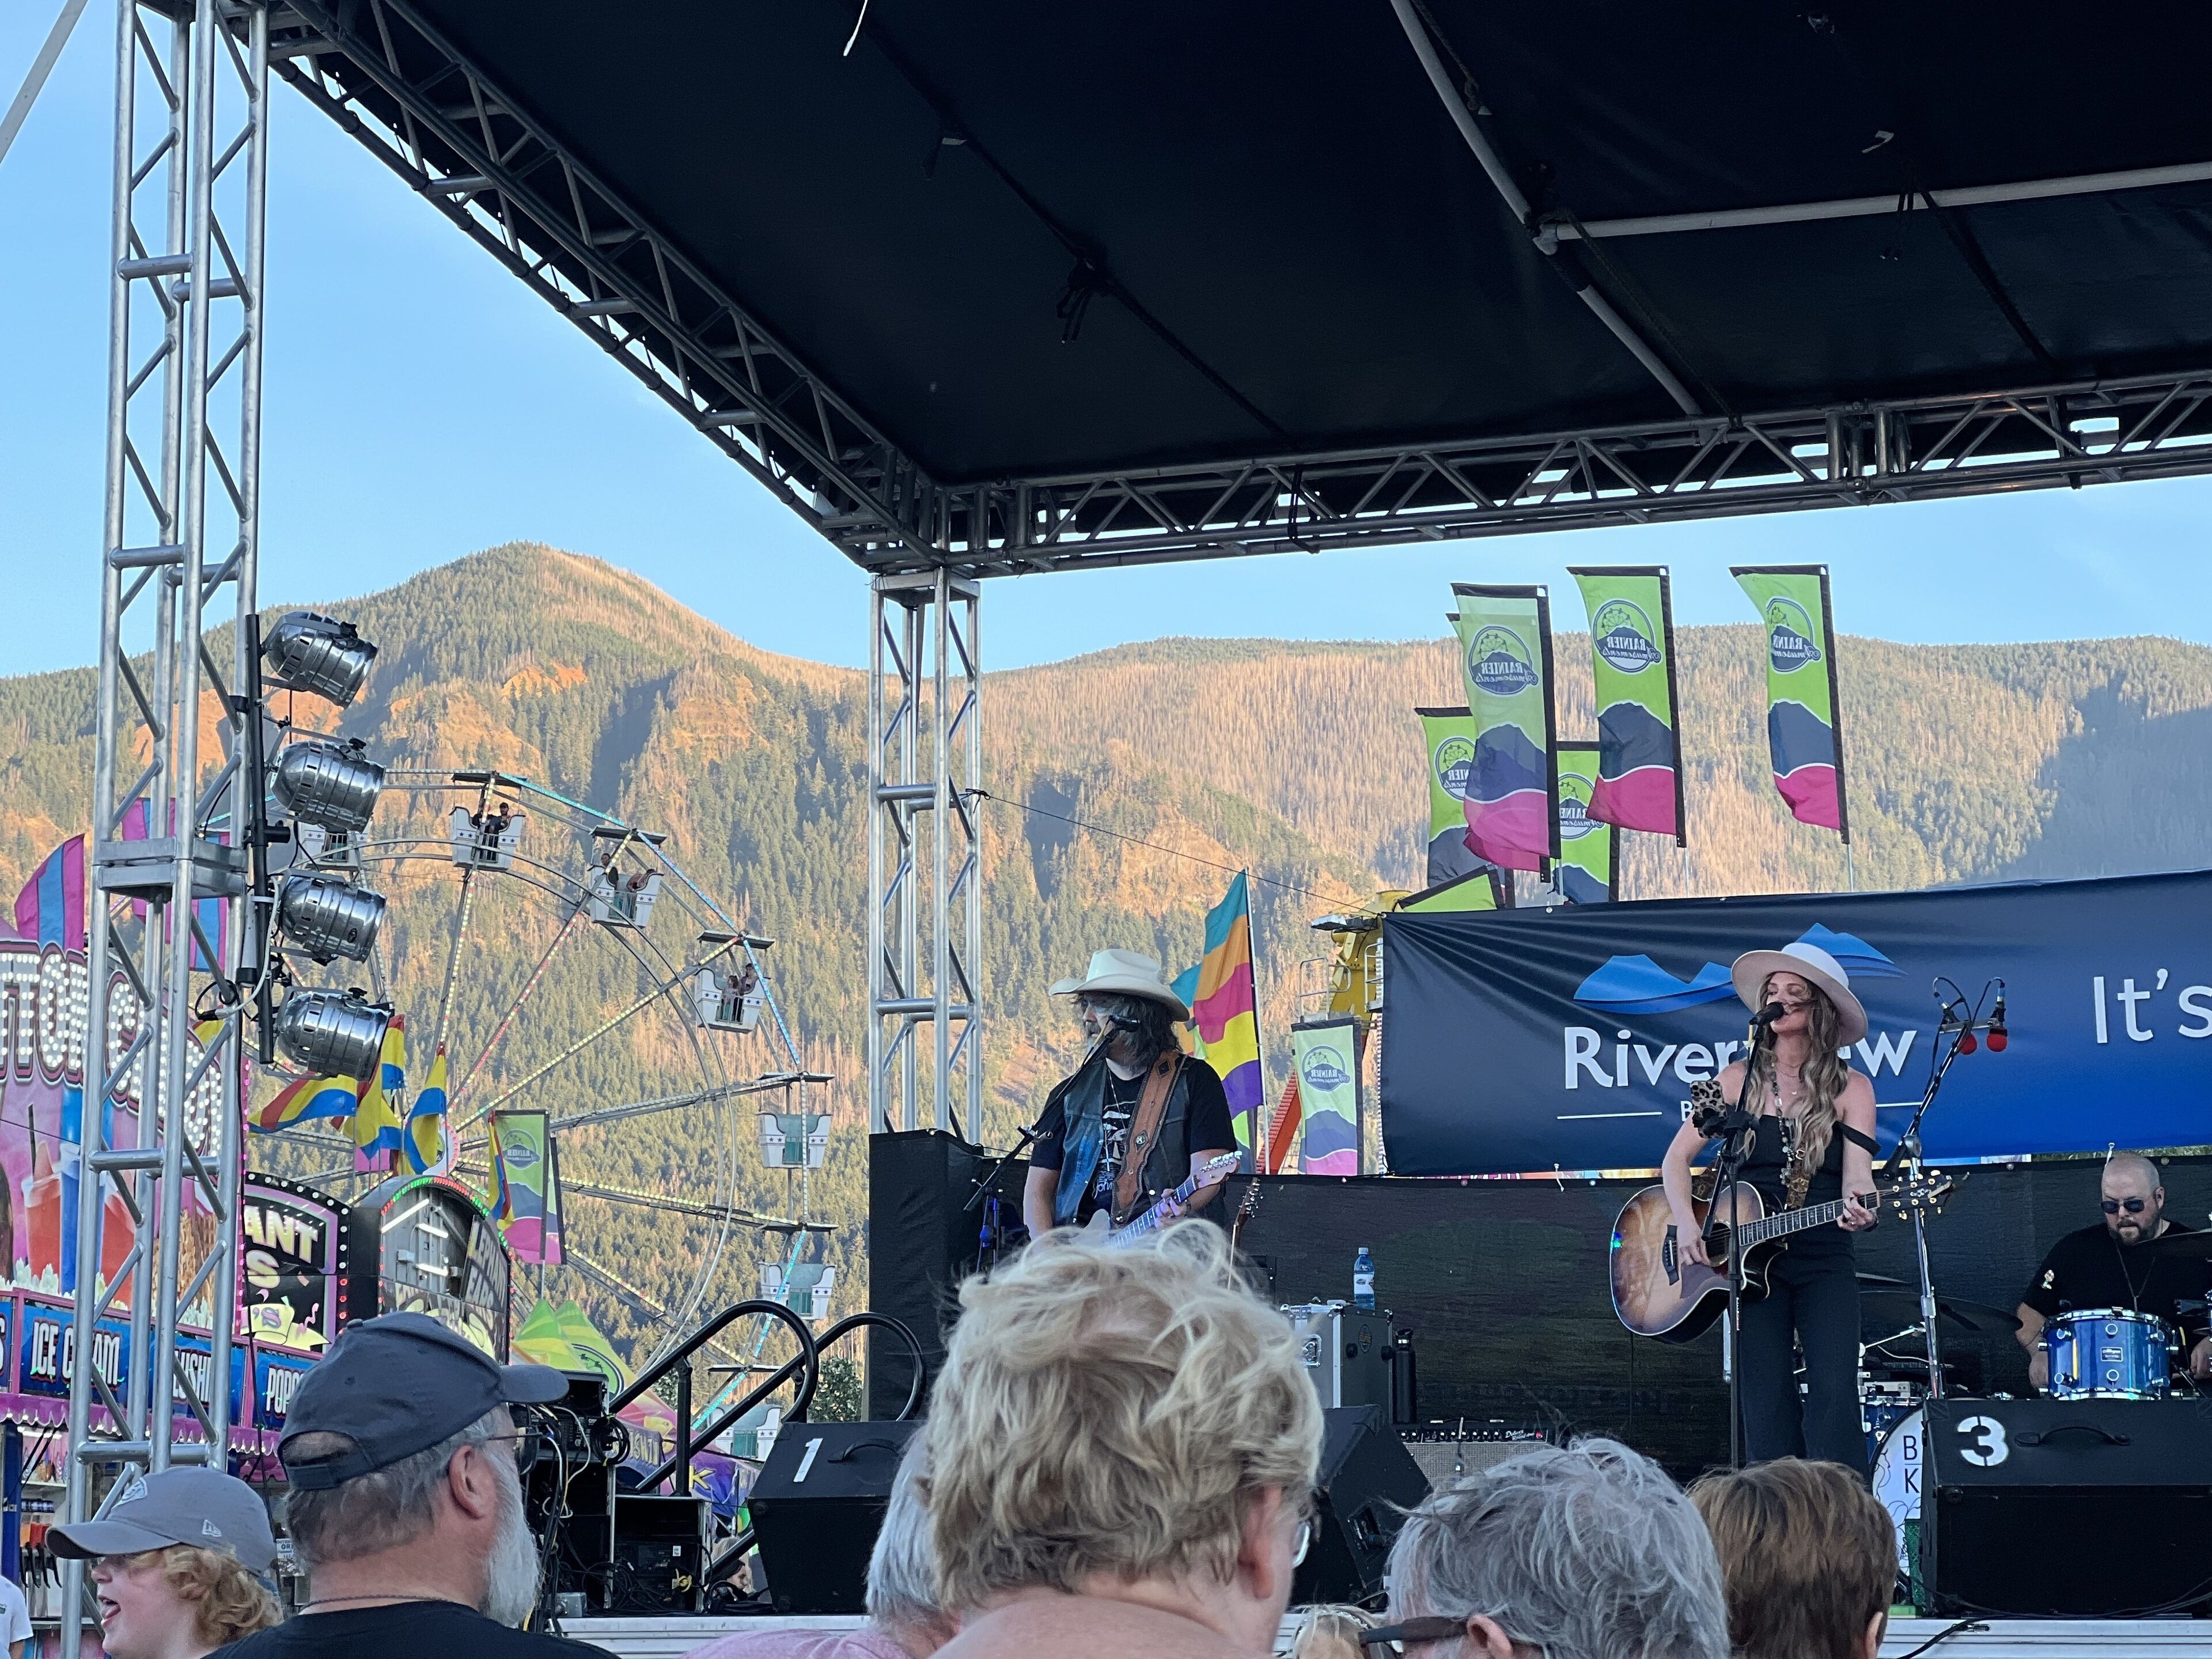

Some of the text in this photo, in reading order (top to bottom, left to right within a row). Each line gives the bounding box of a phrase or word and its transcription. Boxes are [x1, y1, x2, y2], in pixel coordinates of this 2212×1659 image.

[1565, 1027, 1917, 1090] Riverw
[31, 1322, 59, 1376] ICE
[62, 1327, 120, 1385] CAM
[793, 1438, 823, 1483] 1
[1903, 1435, 1918, 1460] B
[1957, 1416, 2009, 1467] 3
[1904, 1468, 1920, 1493] K
